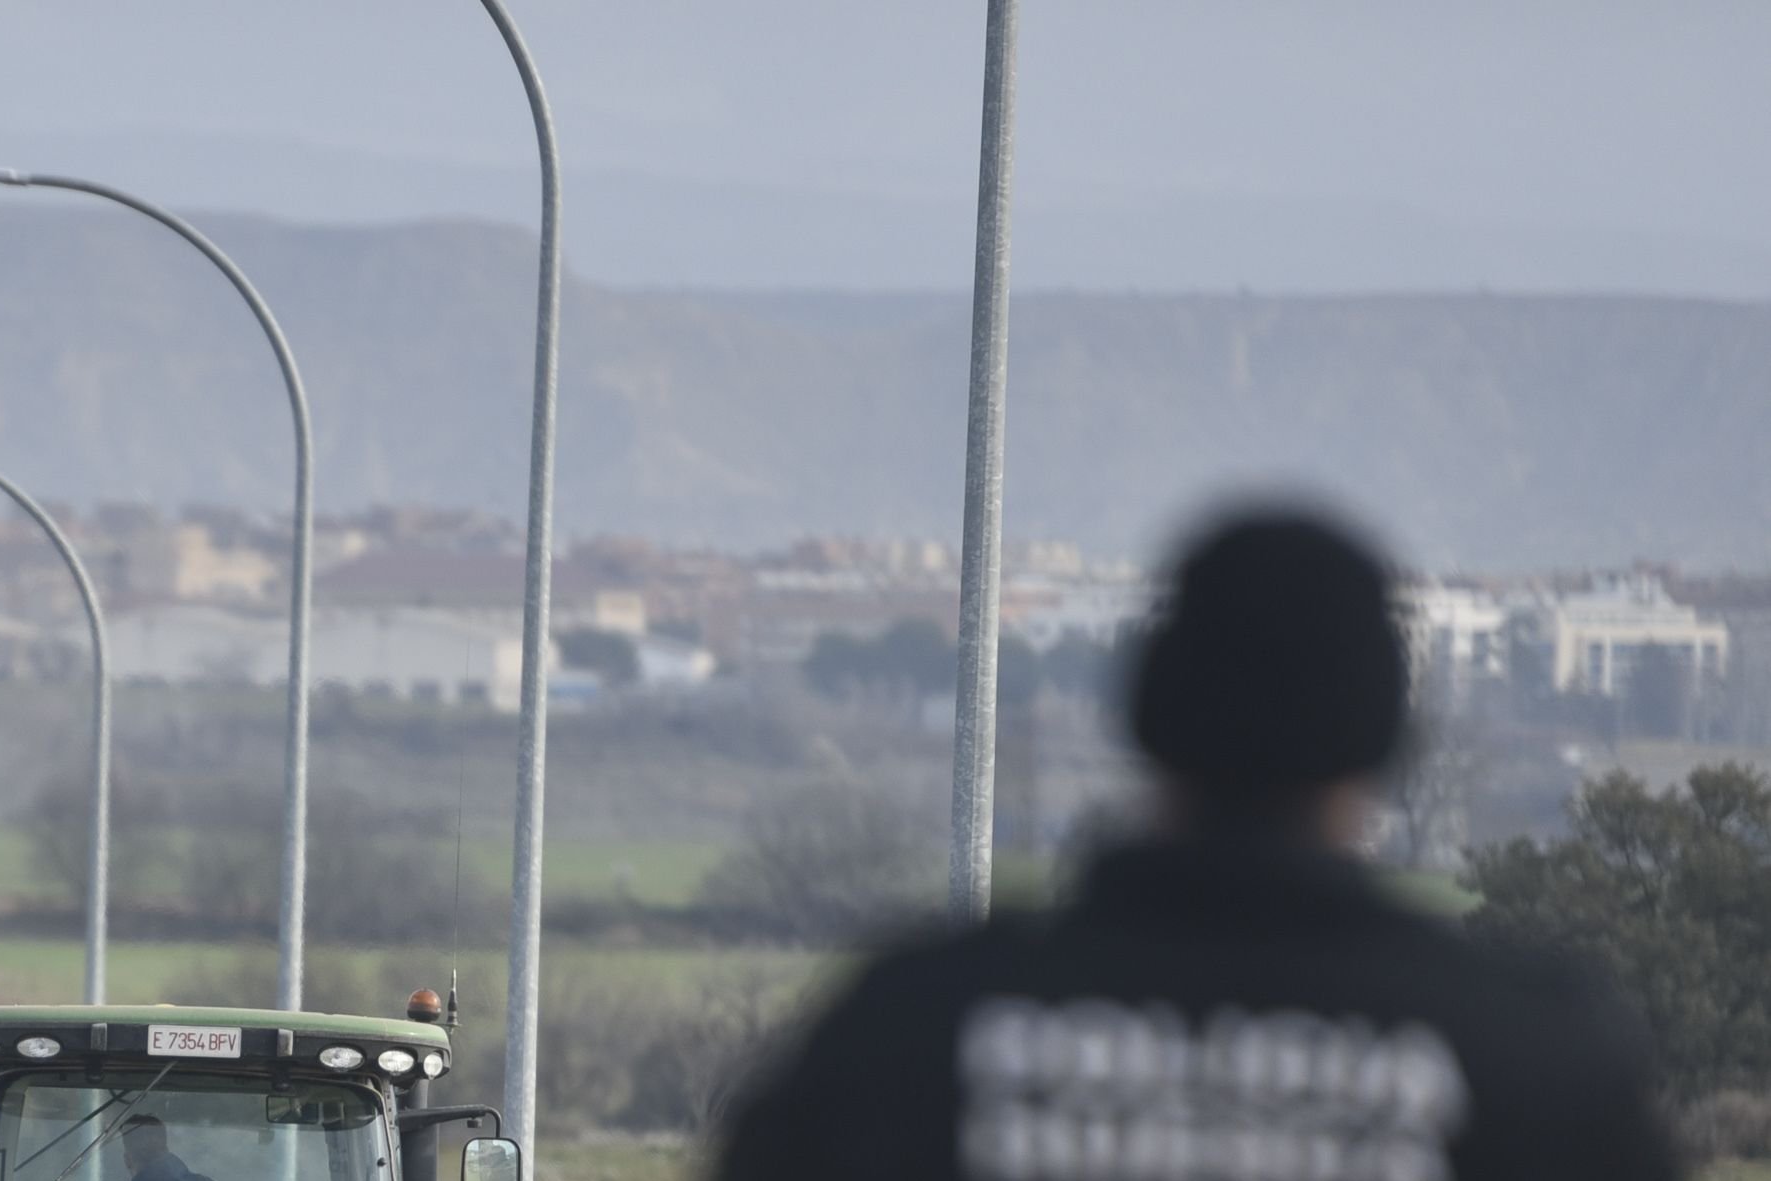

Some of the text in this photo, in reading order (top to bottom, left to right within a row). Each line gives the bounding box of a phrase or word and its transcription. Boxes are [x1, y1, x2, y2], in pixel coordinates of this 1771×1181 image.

[153, 1031, 237, 1051] E 7354 BFV
